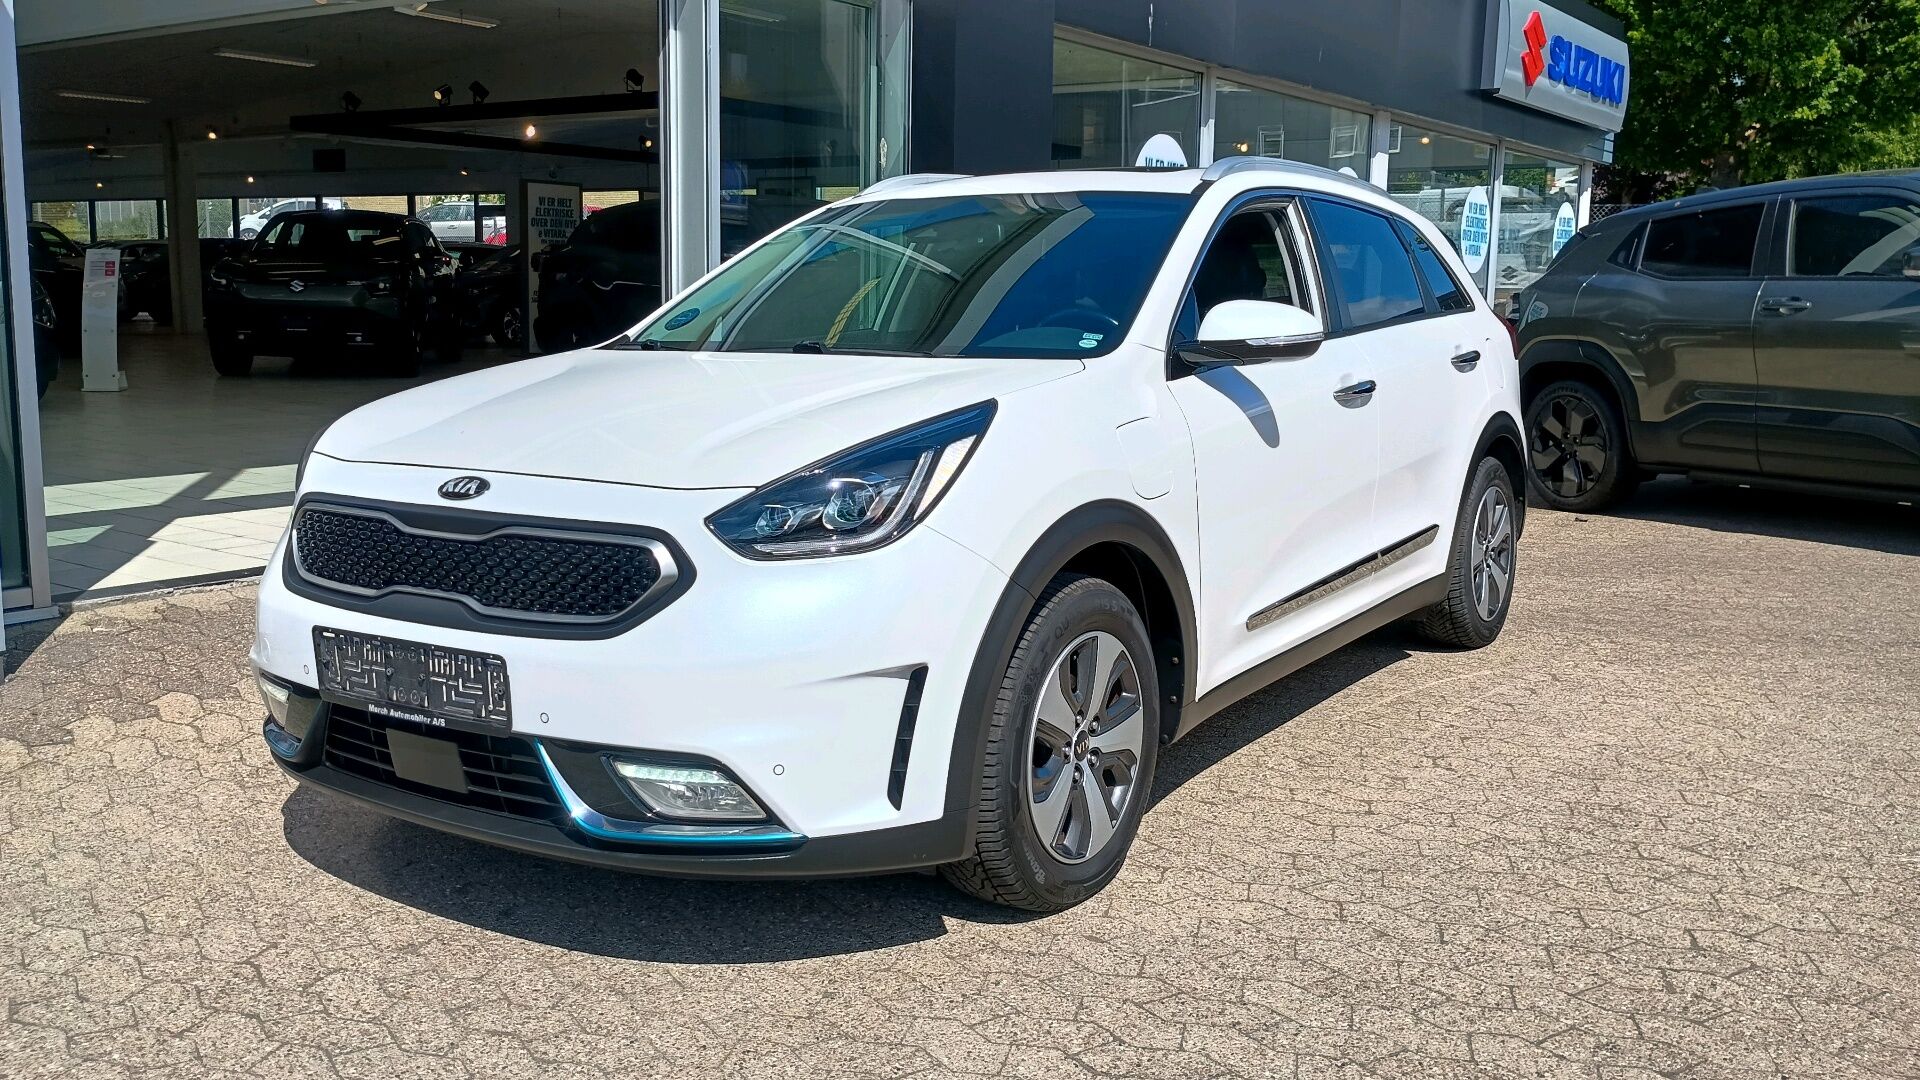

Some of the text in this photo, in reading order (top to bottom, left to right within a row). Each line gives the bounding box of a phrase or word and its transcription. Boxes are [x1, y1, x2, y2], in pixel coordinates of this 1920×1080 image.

[1547, 34, 1625, 105] SUZUKI
[538, 197, 573, 208] VI ER HELT
[536, 208, 575, 219] ELEKTRISKE
[530, 218, 549, 228] OVER
[550, 219, 563, 228] DEN
[442, 478, 481, 495] KIA
[389, 708, 431, 724] Automobiler
[432, 717, 446, 727] A/S
